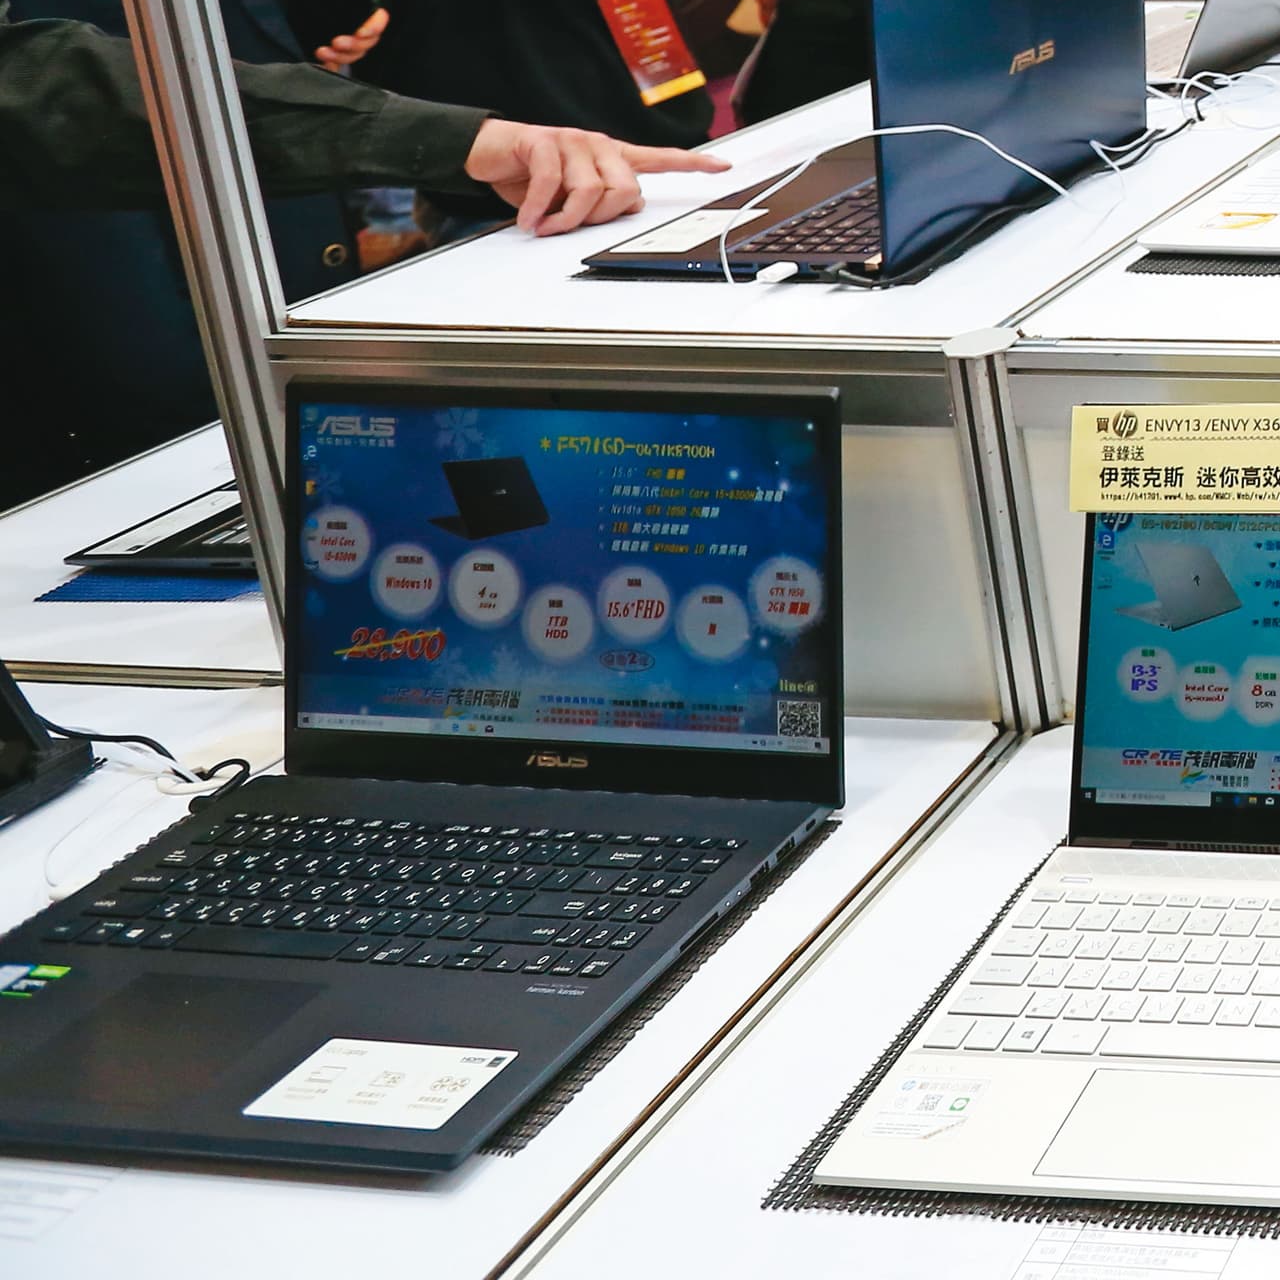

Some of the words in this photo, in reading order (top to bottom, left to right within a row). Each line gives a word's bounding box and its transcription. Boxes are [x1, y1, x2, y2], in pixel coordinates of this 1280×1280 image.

[1009, 39, 1055, 77] ASUS
[317, 416, 395, 437] ASUS
[1096, 418, 1110, 434] 買
[1112, 409, 1138, 437] hp
[1145, 418, 1201, 433] ENVY13
[1204, 417, 1251, 433] /ENVY
[1101, 445, 1145, 463] 登錄送
[1099, 466, 1184, 489] 伊萊克斯
[385, 576, 421, 590] Windows
[423, 578, 433, 590] 10
[545, 629, 569, 639] HDD
[1131, 679, 1158, 691] IPS
[1185, 684, 1205, 693] Intel
[1208, 685, 1230, 693] Core
[526, 752, 588, 768] ASUS
[1184, 751, 1257, 769] 茂訊電腦
